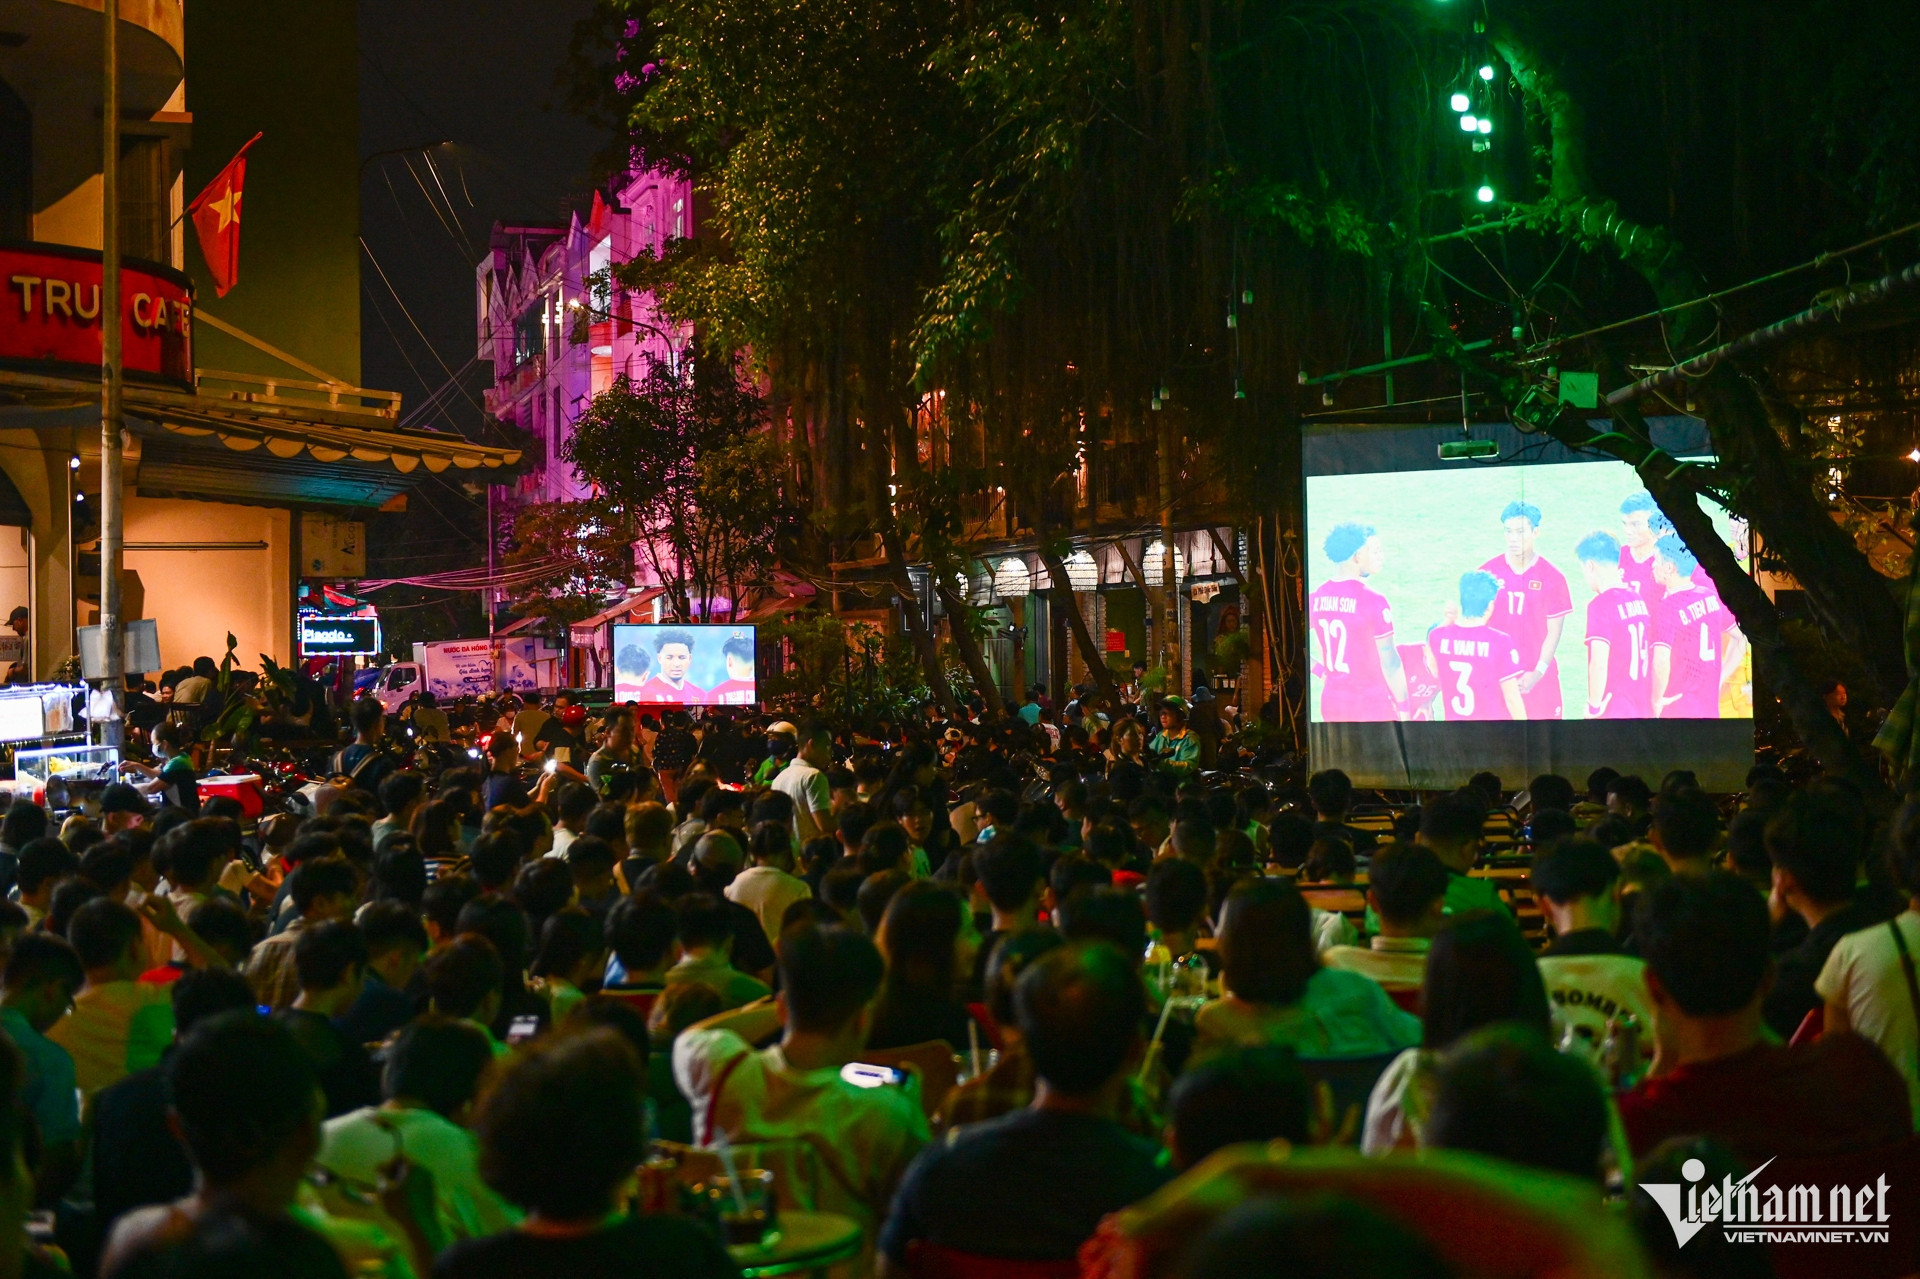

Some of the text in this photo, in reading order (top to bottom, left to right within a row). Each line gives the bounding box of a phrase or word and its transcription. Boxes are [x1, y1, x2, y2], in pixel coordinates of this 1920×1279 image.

[12, 275, 103, 320] TRU
[1339, 597, 1357, 615] SON
[1507, 590, 1525, 616] 17
[1318, 618, 1350, 674] 12
[1699, 621, 1716, 663] 4
[1448, 661, 1475, 717] 3
